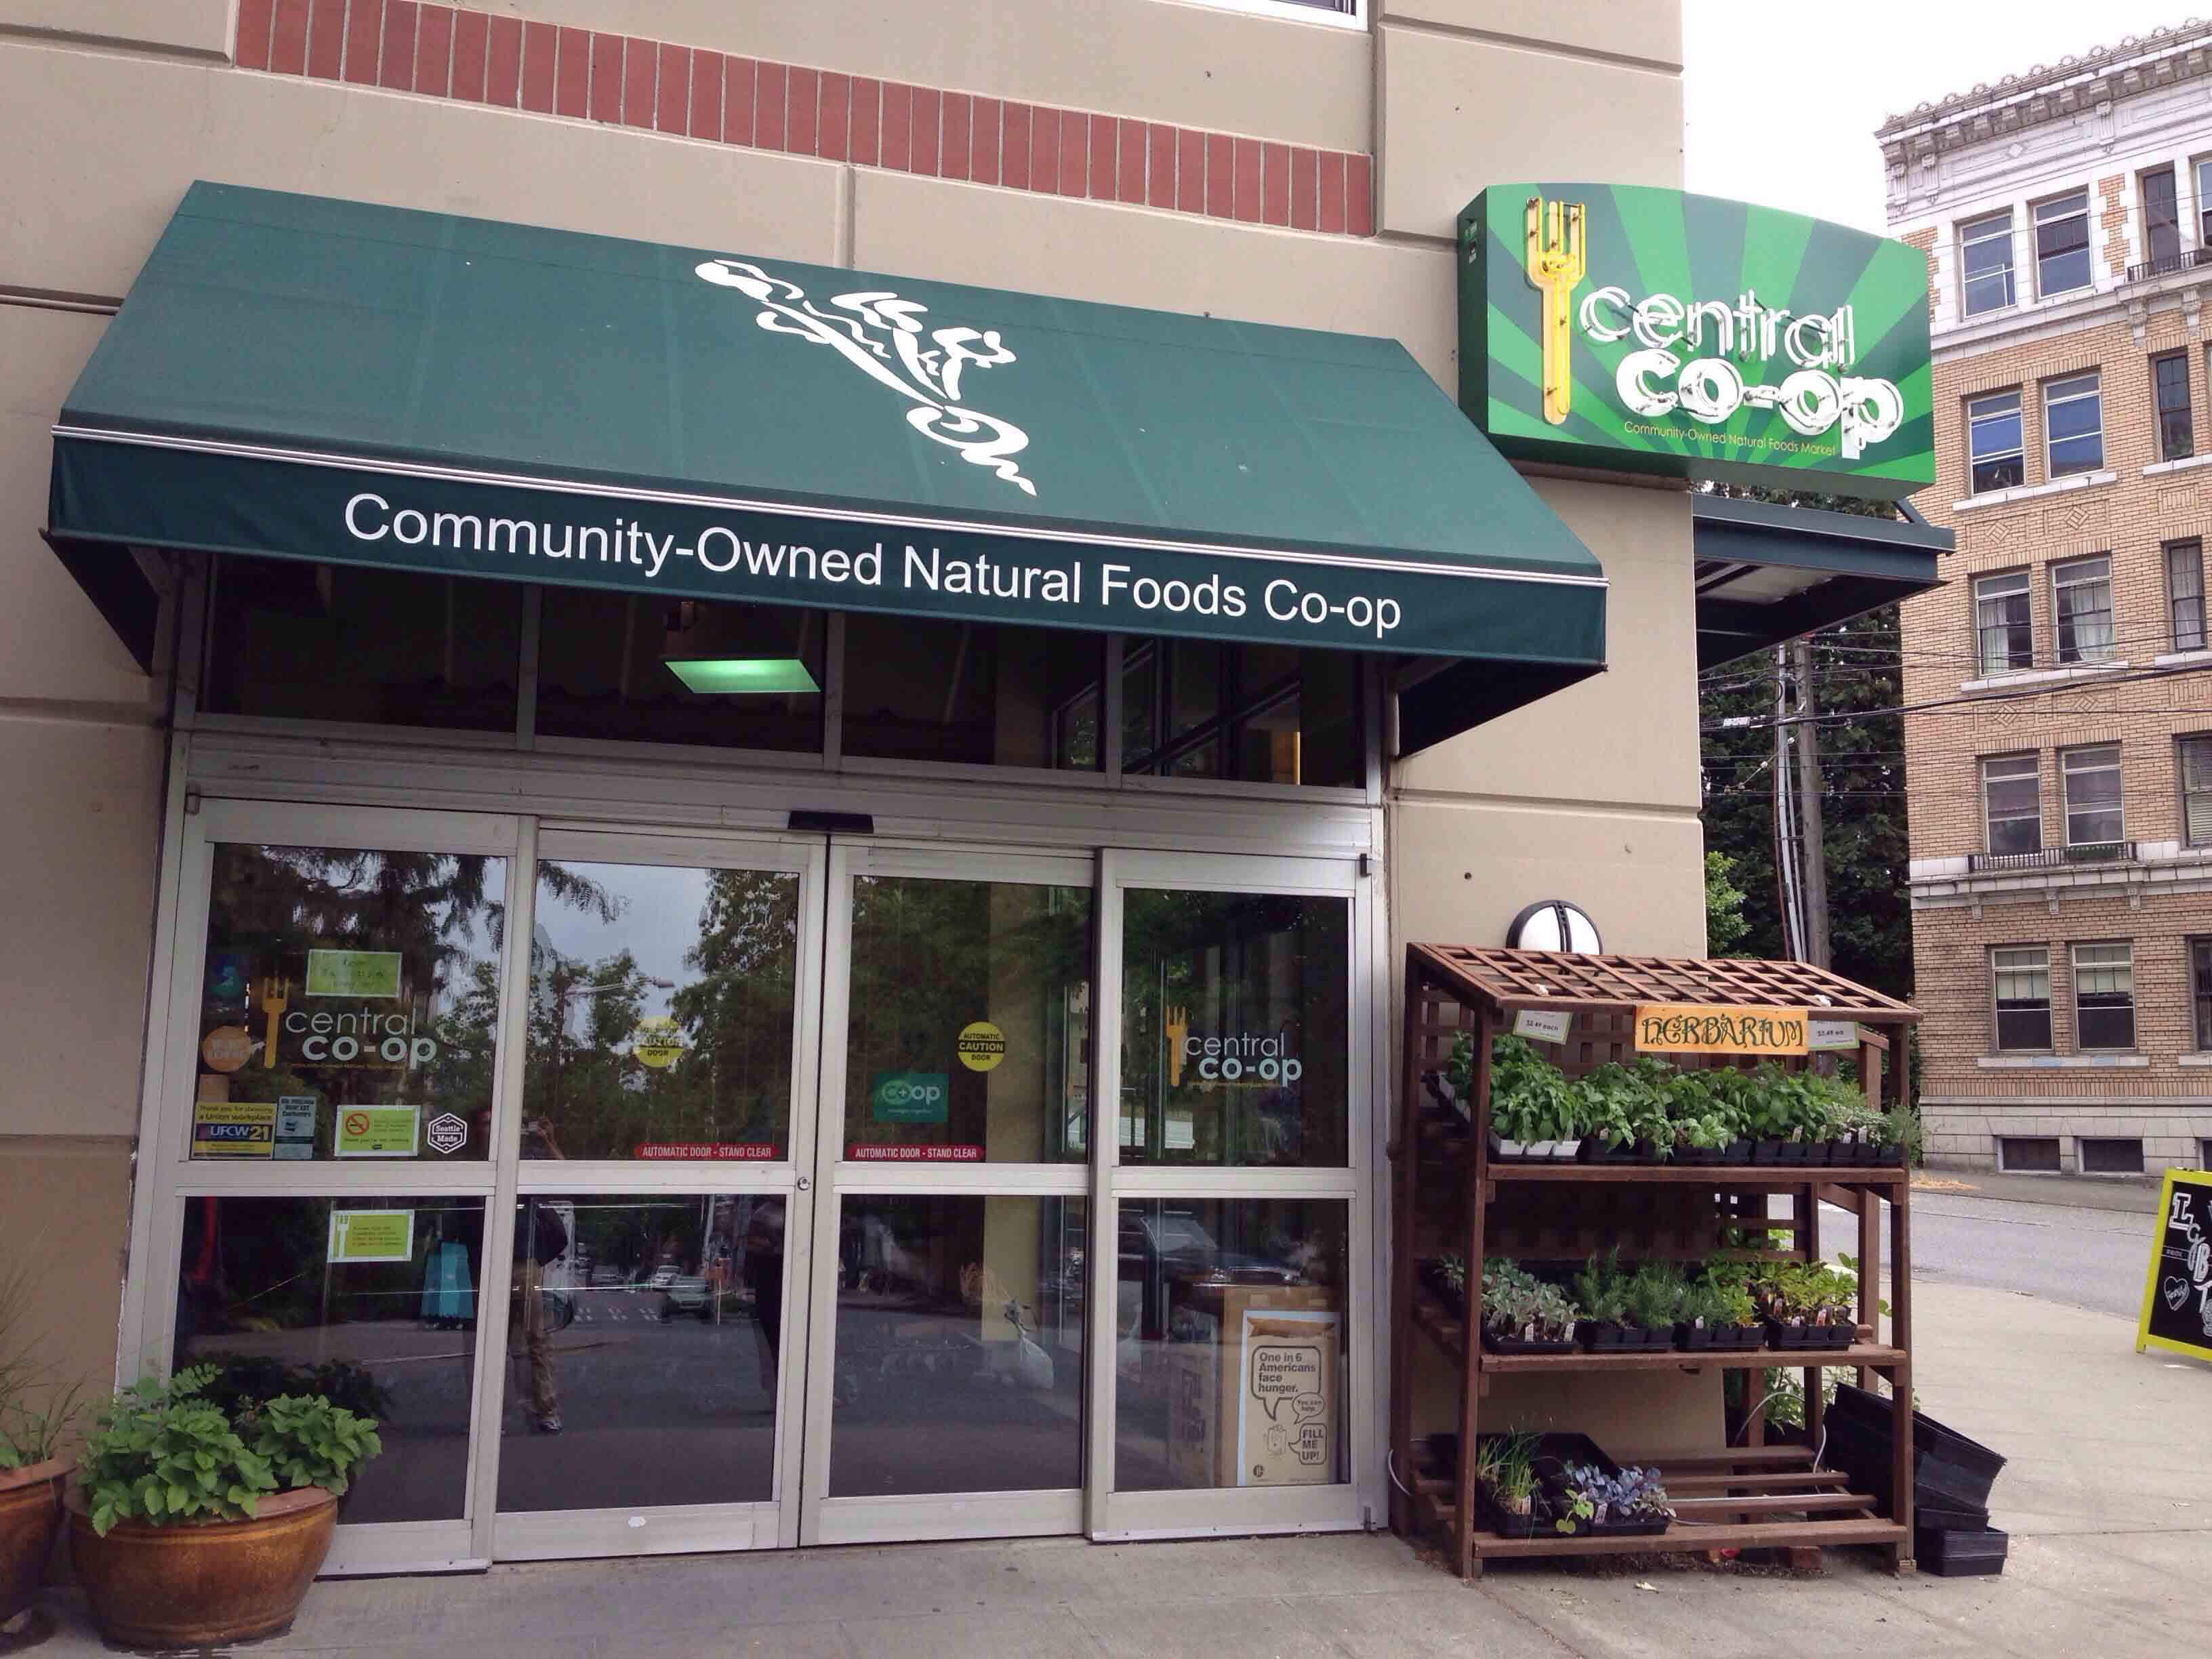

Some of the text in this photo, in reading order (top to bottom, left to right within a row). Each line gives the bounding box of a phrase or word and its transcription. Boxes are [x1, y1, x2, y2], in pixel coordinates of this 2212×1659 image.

[1579, 286, 1854, 370] central
[1616, 346, 1904, 460] co-op
[1624, 421, 1836, 456] Community-Owned Natural Foods Market
[344, 493, 1401, 638] Community-Owned Natural Foods Co-op
[286, 1006, 416, 1036] central
[1643, 1013, 1806, 1048] HERBARIUM
[959, 1041, 1004, 1051] CAUTION
[1186, 1031, 1284, 1057] central
[302, 1036, 438, 1069] co-op
[971, 1053, 991, 1061] DOOR
[1198, 1057, 1302, 1088] co-op
[210, 1126, 270, 1140] UFCW 21
[435, 1124, 462, 1132] Seattle
[437, 1135, 458, 1143] Made
[643, 1147, 688, 1157] AUTOMATIC
[690, 1147, 711, 1157] DOOR
[719, 1147, 745, 1157] STAND
[747, 1147, 771, 1157] CLEAR
[855, 1148, 899, 1158] AUTOMATIC
[900, 1148, 920, 1158] DOOR
[927, 1148, 951, 1158] STAND
[954, 1148, 977, 1158] CLEAR
[1259, 1352, 1302, 1362] One in 6
[1258, 1363, 1316, 1372] Americans
[1258, 1372, 1283, 1382] face
[1258, 1383, 1298, 1393] hunger.
[1303, 1429, 1324, 1439] FILL
[1303, 1440, 1317, 1449] ME
[1302, 1451, 1319, 1460] UP!
